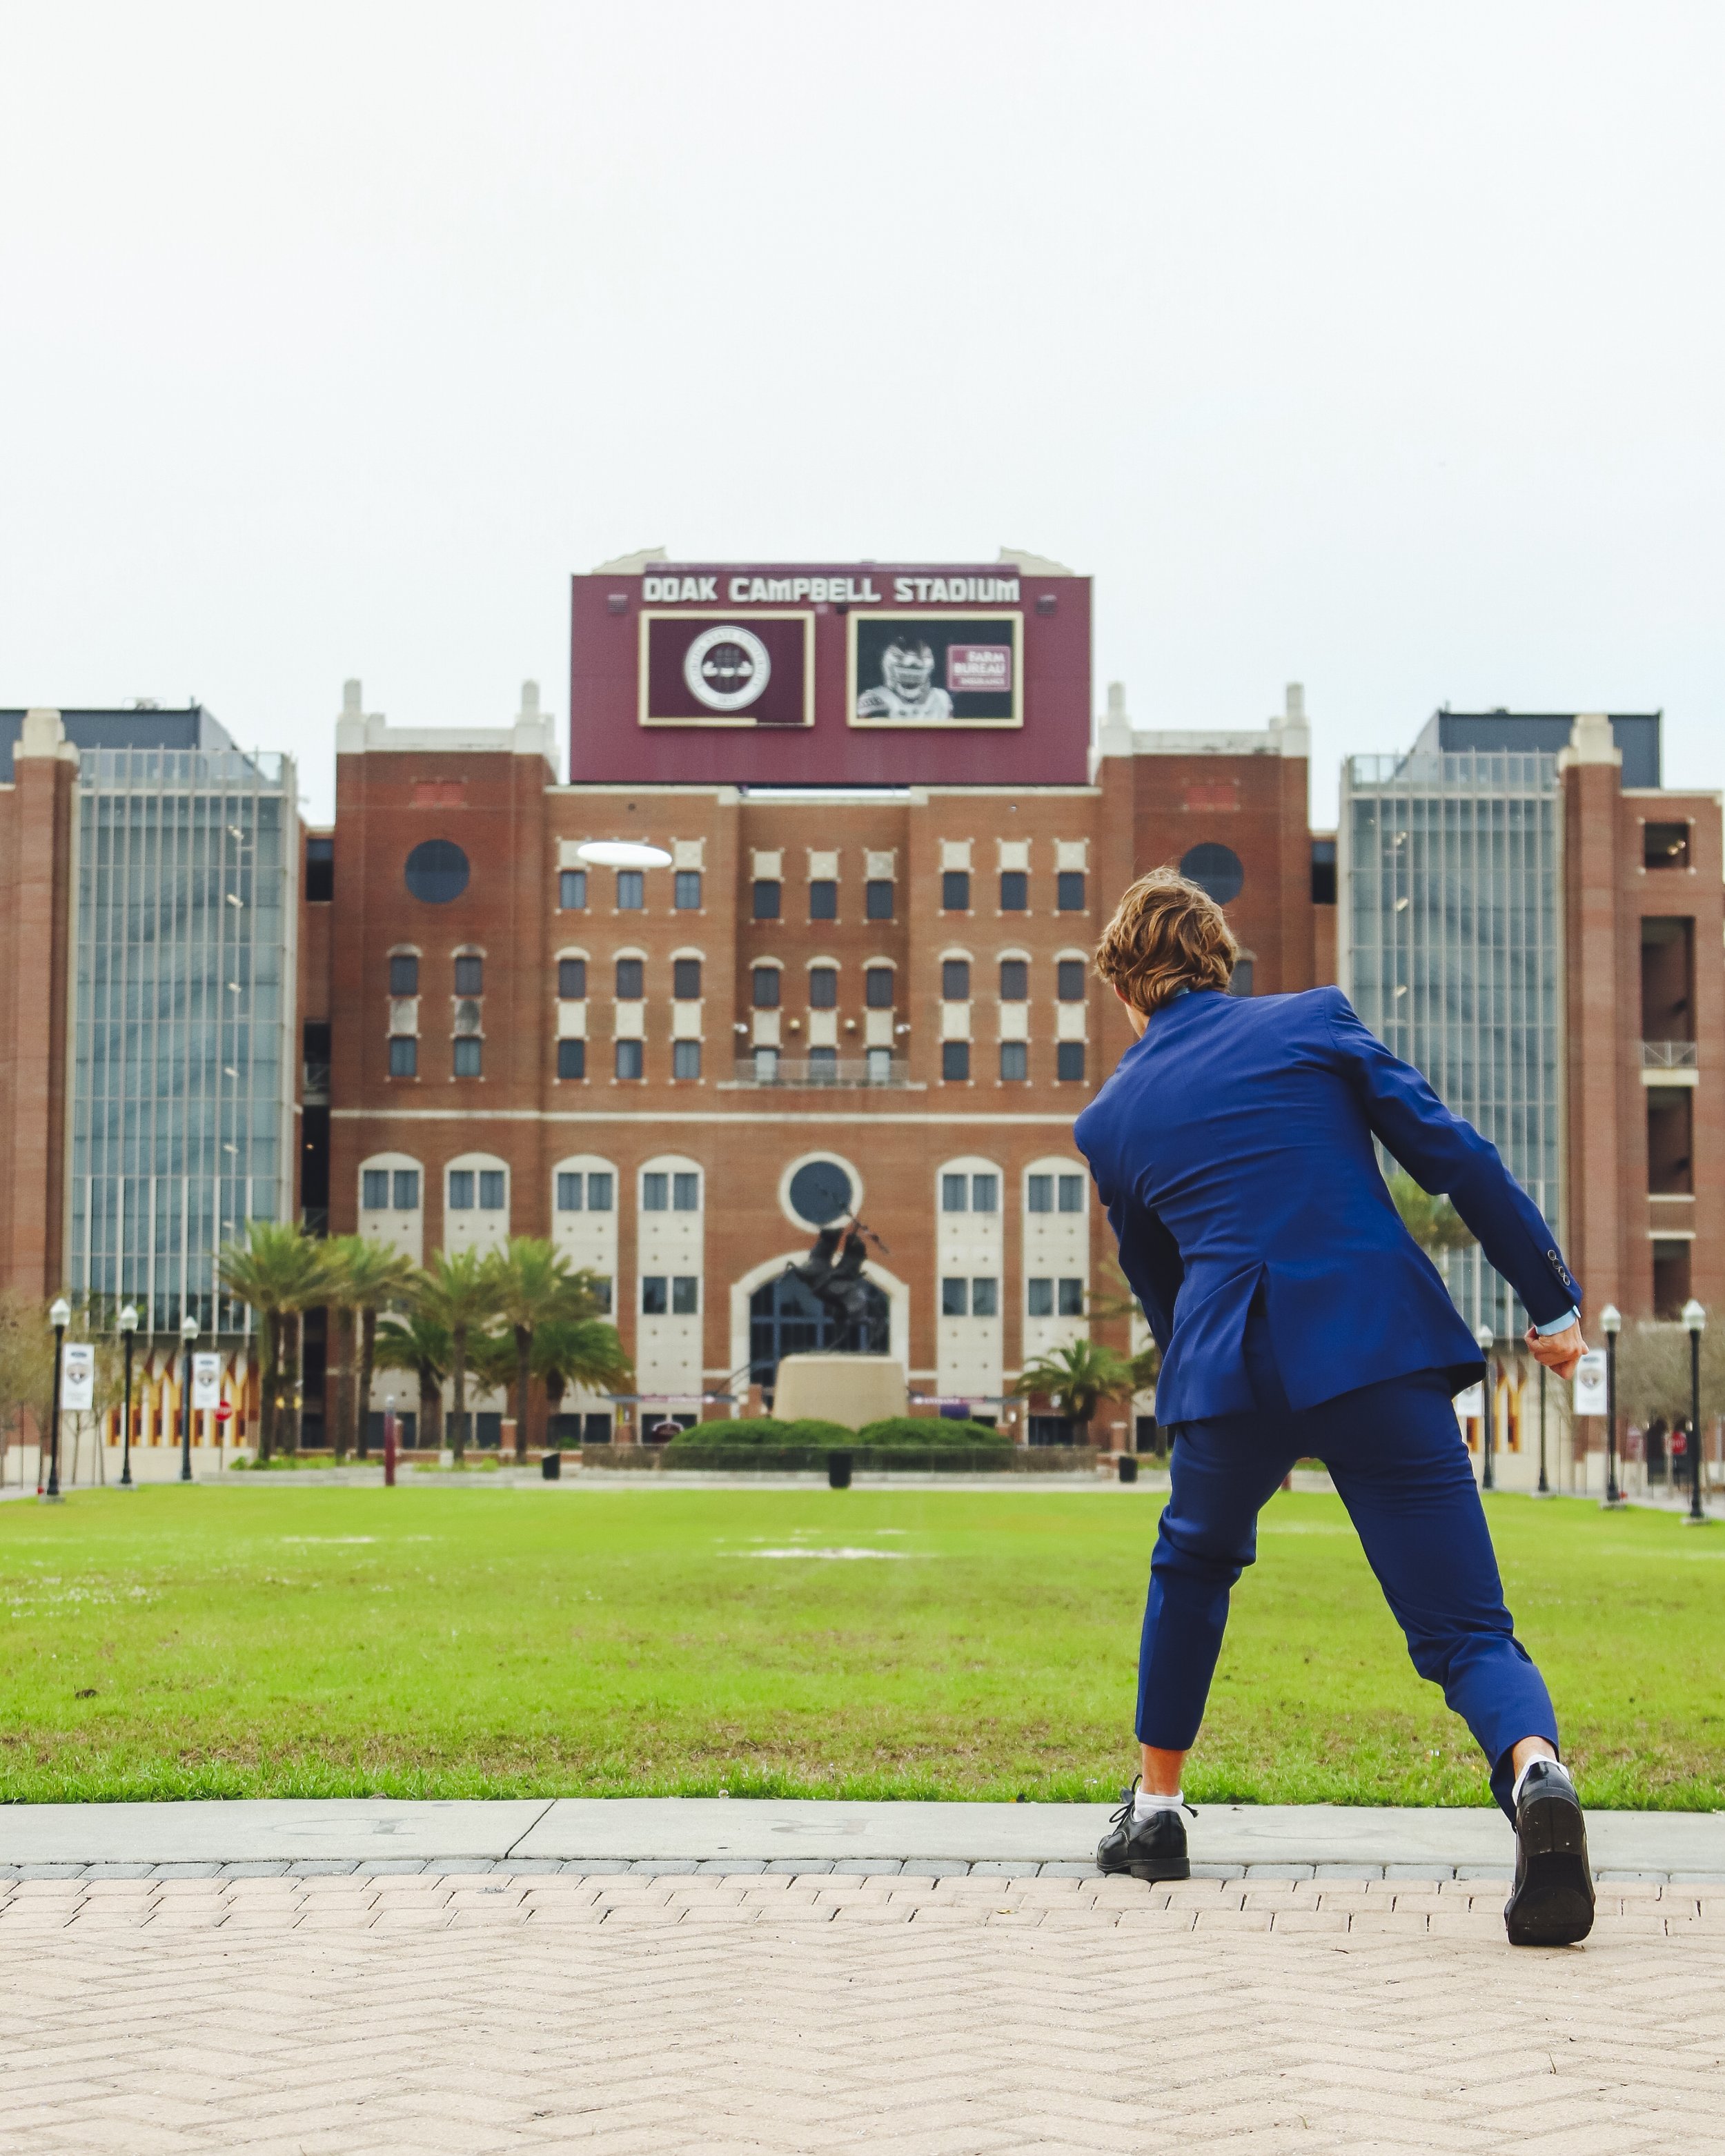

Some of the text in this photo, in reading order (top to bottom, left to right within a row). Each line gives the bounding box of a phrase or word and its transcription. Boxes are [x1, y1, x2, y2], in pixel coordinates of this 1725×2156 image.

[642, 577, 1021, 603] DOAK CAMPBELL STADIUM
[968, 651, 1005, 662] FARM
[954, 662, 1005, 673] BUREAU
